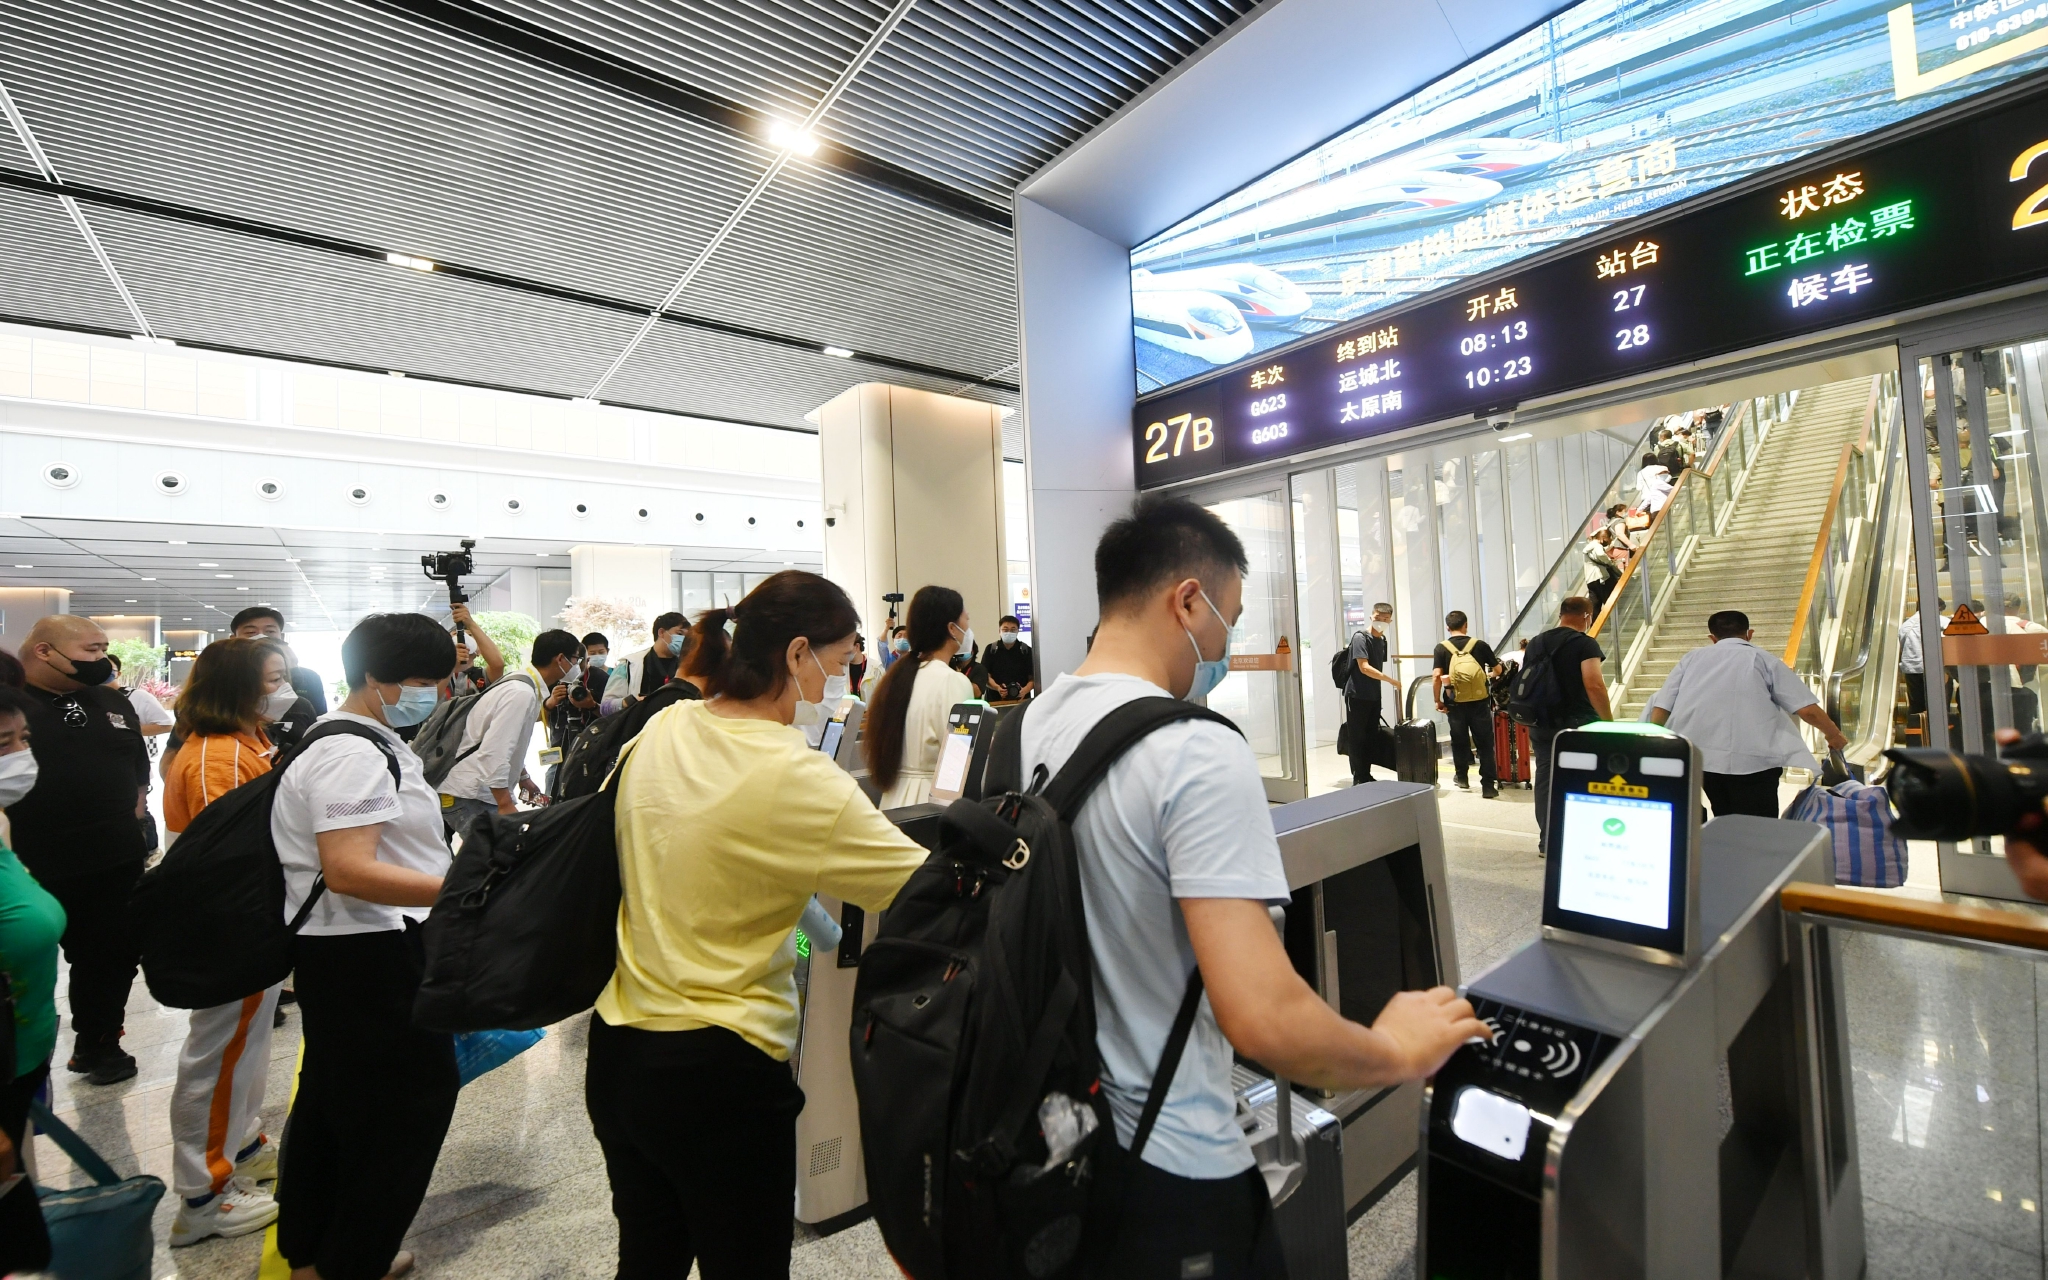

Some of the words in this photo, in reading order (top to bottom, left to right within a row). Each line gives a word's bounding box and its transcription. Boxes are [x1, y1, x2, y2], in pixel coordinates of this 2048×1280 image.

[1956, 3, 2048, 51] 010-6394
[1339, 136, 1677, 297] 京津冀铁路媒体运营商
[1646, 180, 1687, 201] REGION
[1250, 364, 1284, 390] 车次
[1337, 325, 1399, 362] 终到站
[1466, 287, 1519, 321] 开点
[1596, 241, 1659, 279] 站台
[1779, 172, 1865, 220] 状态
[1250, 393, 1287, 417] G623
[1338, 358, 1401, 393] 运城北
[1460, 320, 1528, 356] 08:13
[1613, 284, 1646, 312] 27
[1745, 199, 1915, 276] 正在检票
[1251, 422, 1288, 445] G603
[1340, 390, 1402, 424] 太原南
[1465, 356, 1532, 389] 10:23
[1615, 324, 1650, 350] 28
[1787, 263, 1873, 308] 候车
[1145, 412, 1215, 464] 27B
